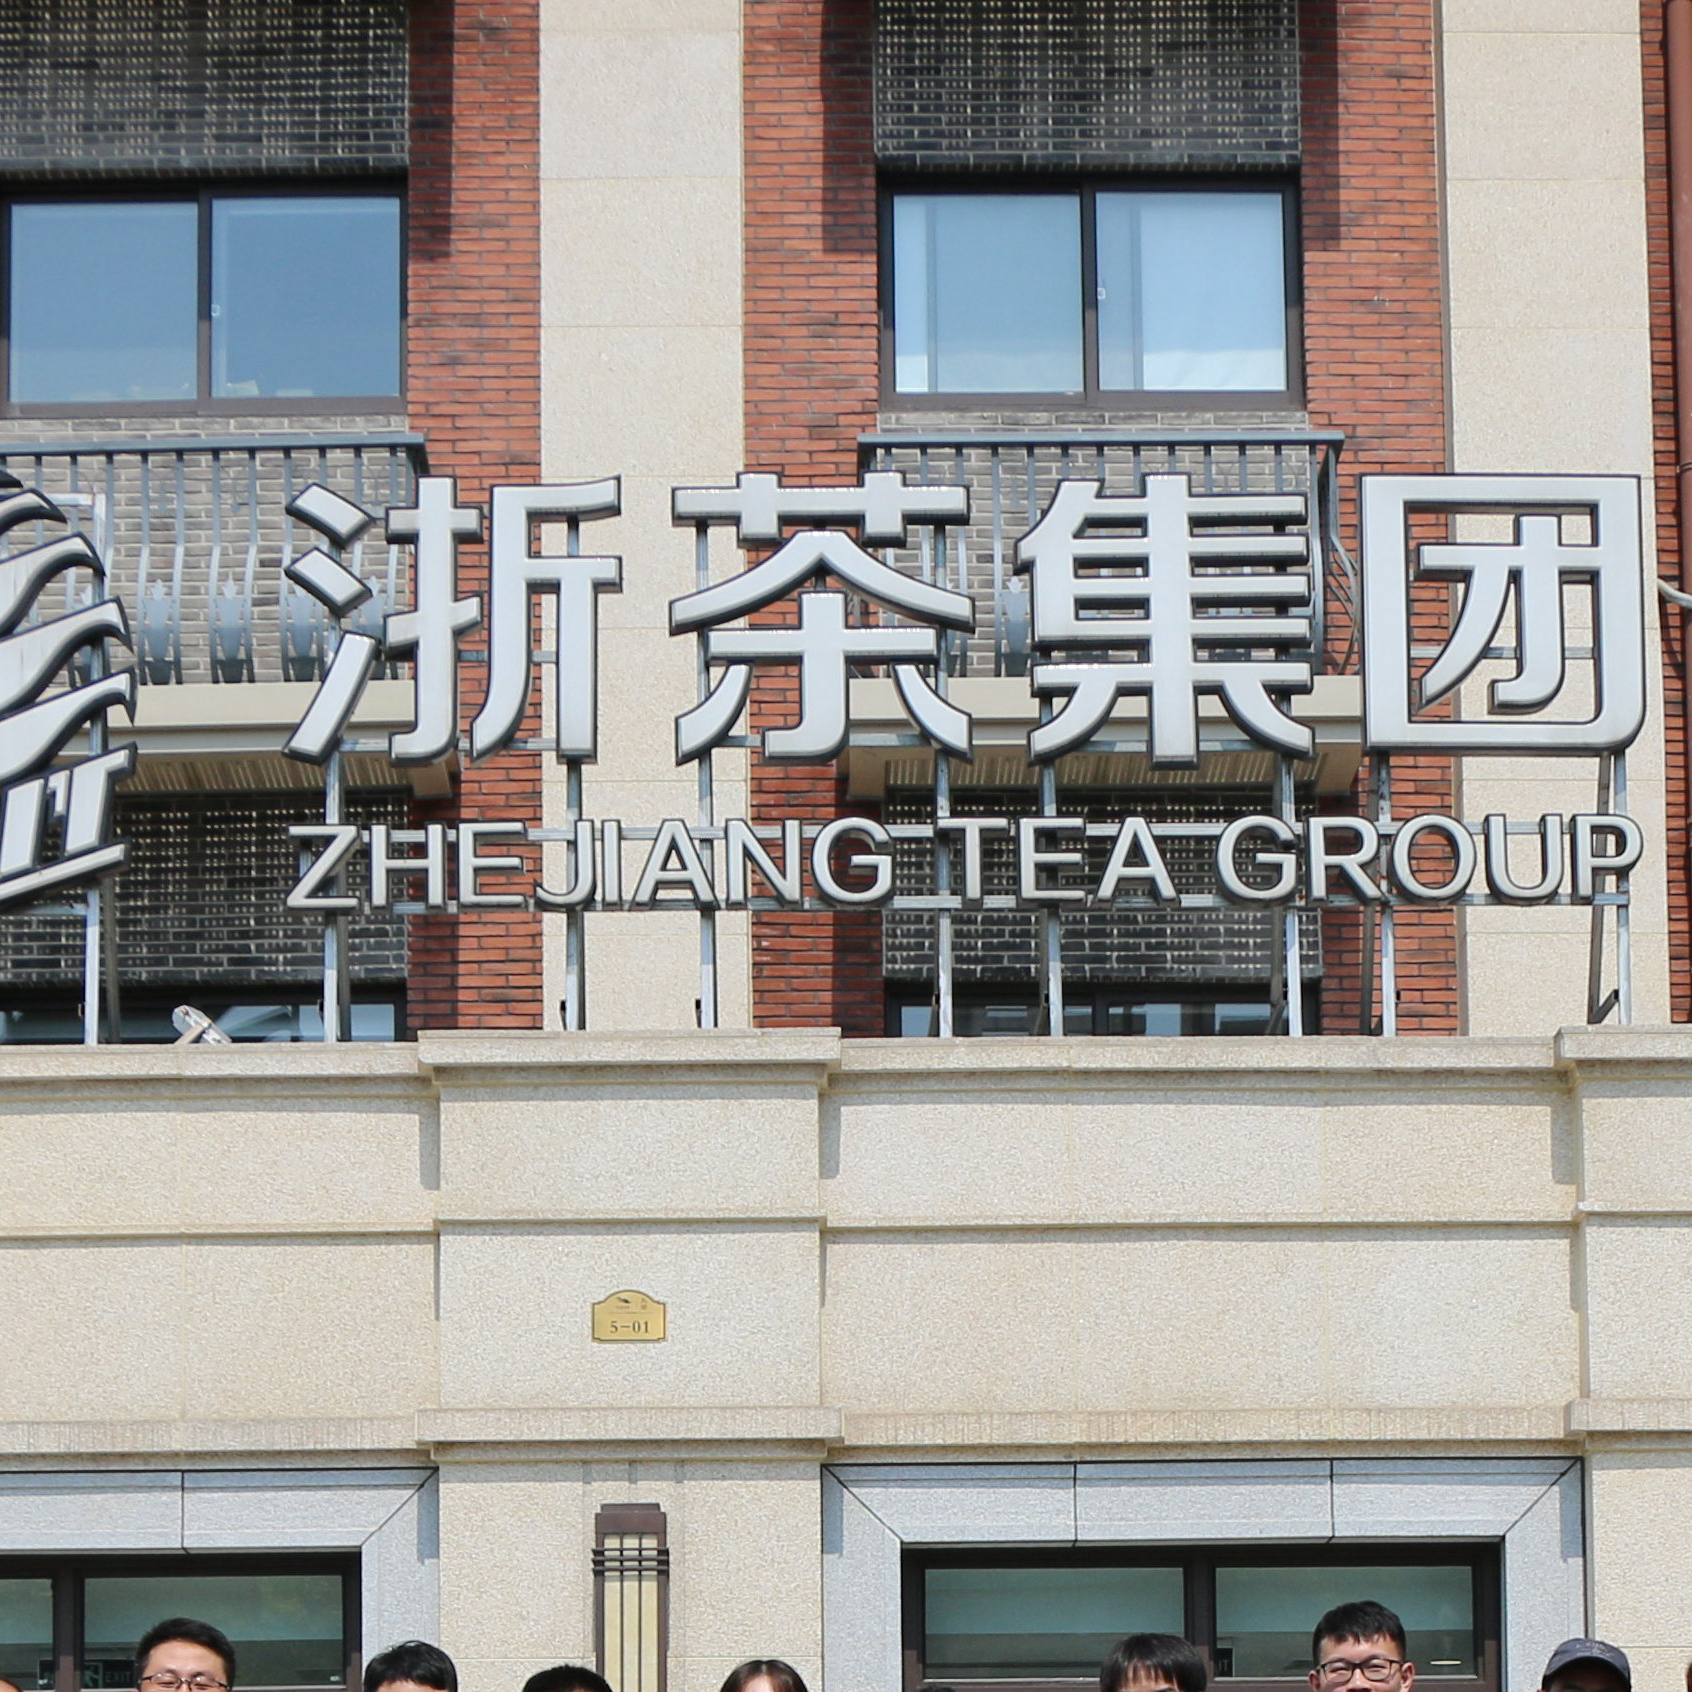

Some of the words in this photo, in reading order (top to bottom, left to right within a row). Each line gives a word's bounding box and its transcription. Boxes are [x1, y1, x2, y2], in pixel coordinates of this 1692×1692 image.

[282, 471, 1647, 770] 浙茶集团
[284, 817, 895, 912] ZHEJIANG
[936, 815, 1181, 908] TEA
[1215, 813, 1645, 906] GROUP
